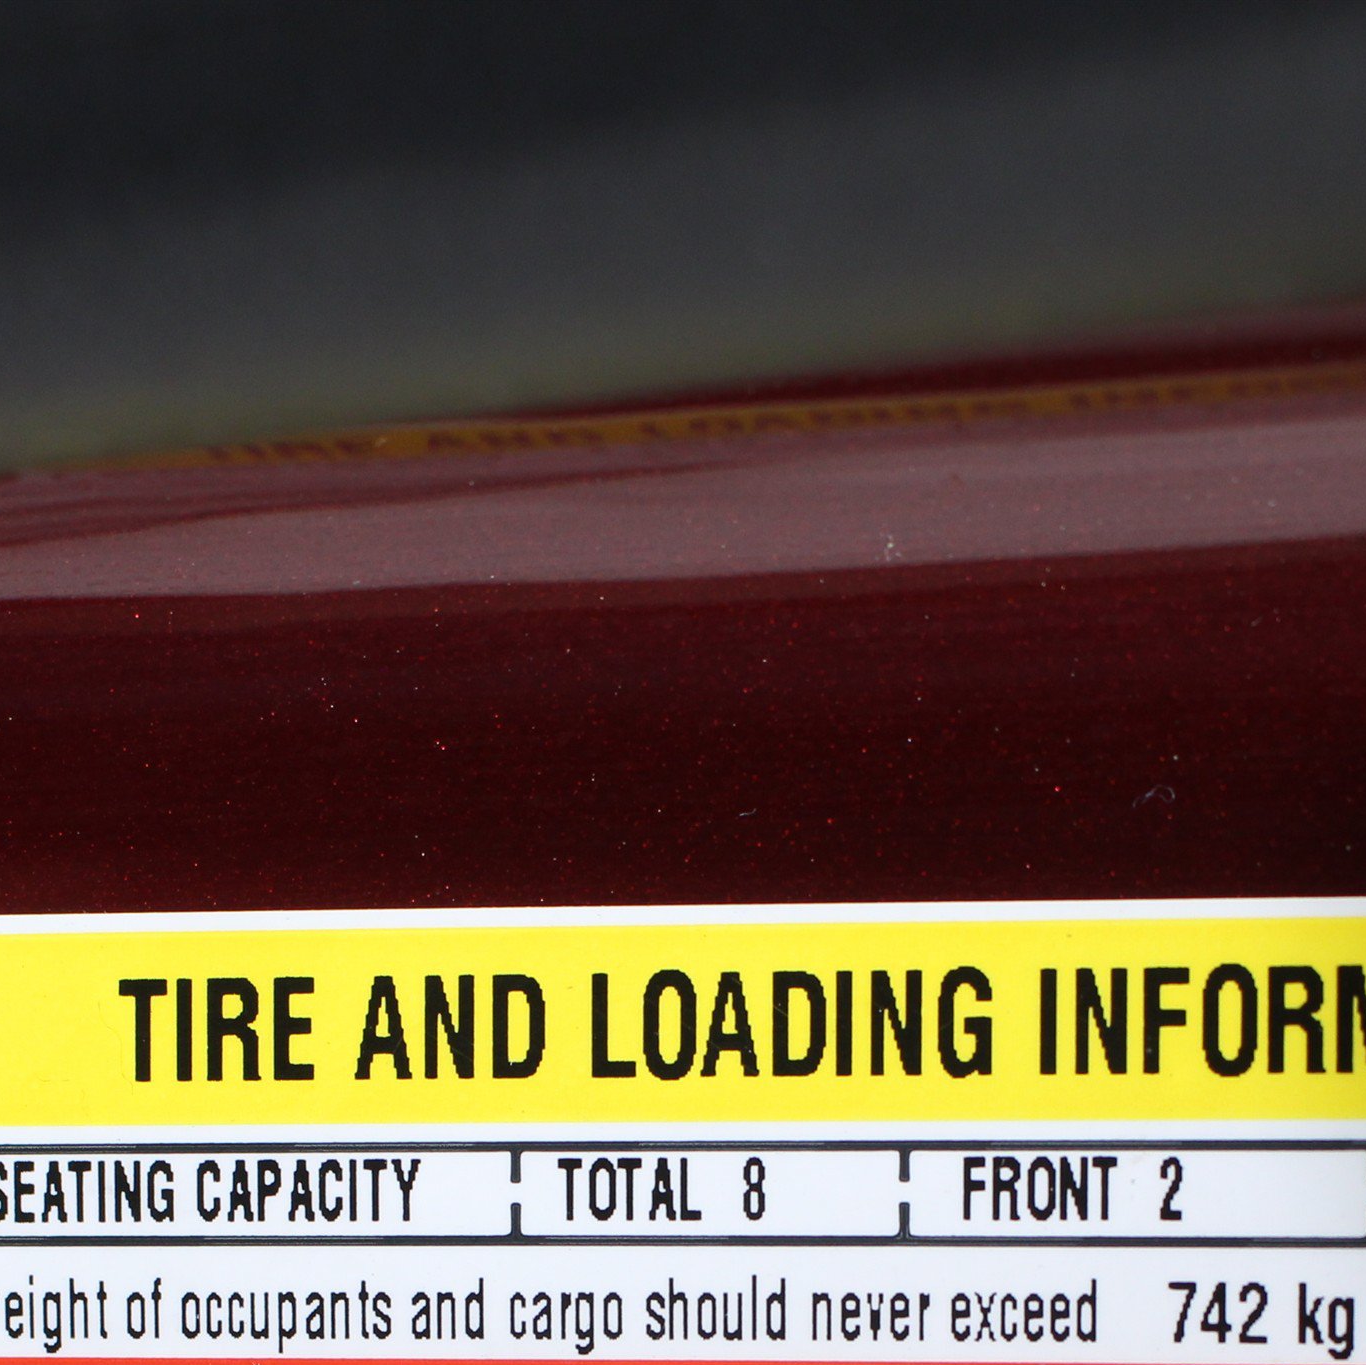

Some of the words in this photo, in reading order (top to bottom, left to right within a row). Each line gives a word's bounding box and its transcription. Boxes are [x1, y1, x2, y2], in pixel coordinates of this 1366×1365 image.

[119, 977, 314, 1081] TIRE
[355, 975, 545, 1079] AND
[592, 967, 996, 1080] LOADING
[197, 1159, 420, 1221] CAPACITY
[558, 1158, 701, 1220] TOTAL
[744, 1158, 765, 1220] 8
[964, 1157, 1117, 1220] FRONT
[1161, 1158, 1182, 1220] 2
[127, 1278, 161, 1339] of
[182, 1281, 391, 1353] occupants
[412, 1278, 483, 1339] and
[511, 1293, 622, 1354] cargo
[647, 1275, 785, 1340] should
[813, 1293, 929, 1340] never
[952, 1280, 1096, 1341] exceed
[1169, 1283, 1267, 1343] 742
[1299, 1283, 1353, 1359] kg
